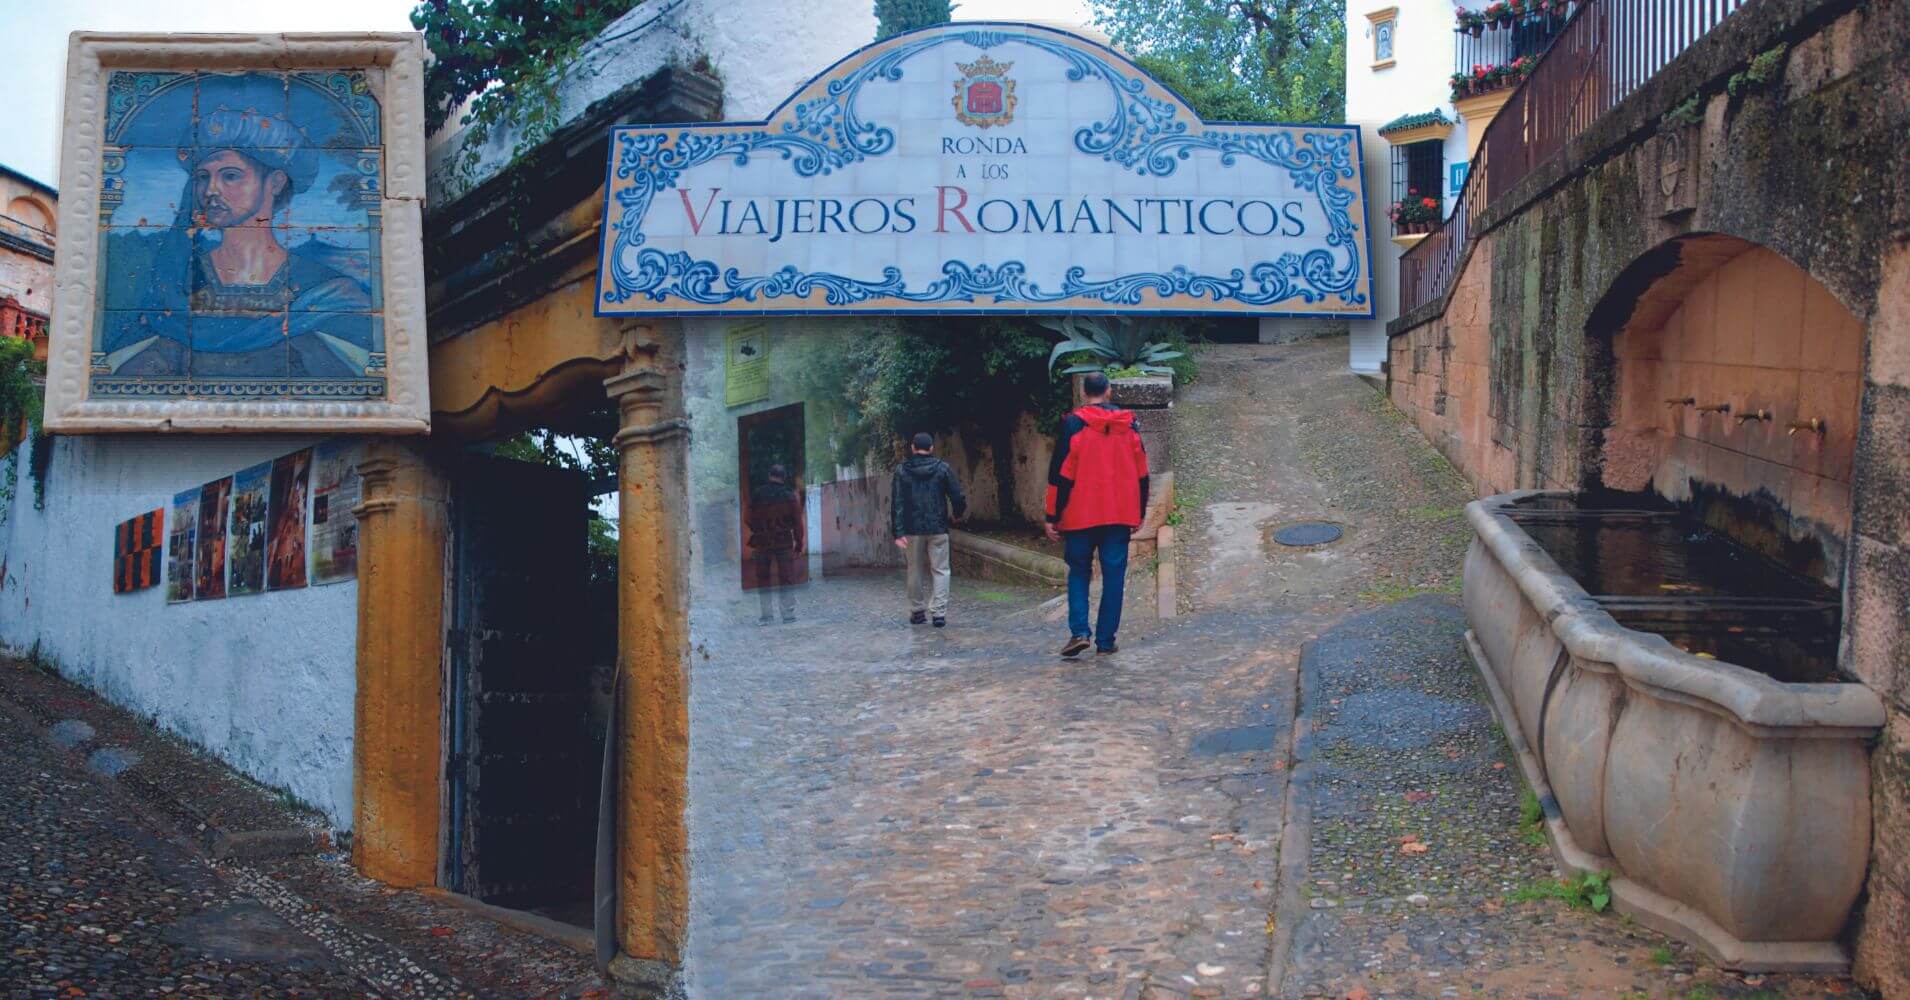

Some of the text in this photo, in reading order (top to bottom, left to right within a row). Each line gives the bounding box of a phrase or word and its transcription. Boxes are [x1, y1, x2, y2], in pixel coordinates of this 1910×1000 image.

[942, 136, 1028, 154] RONDA
[956, 163, 1009, 180] A LOS
[678, 184, 1306, 242] VIAJEROS ROMÁNTICOS
